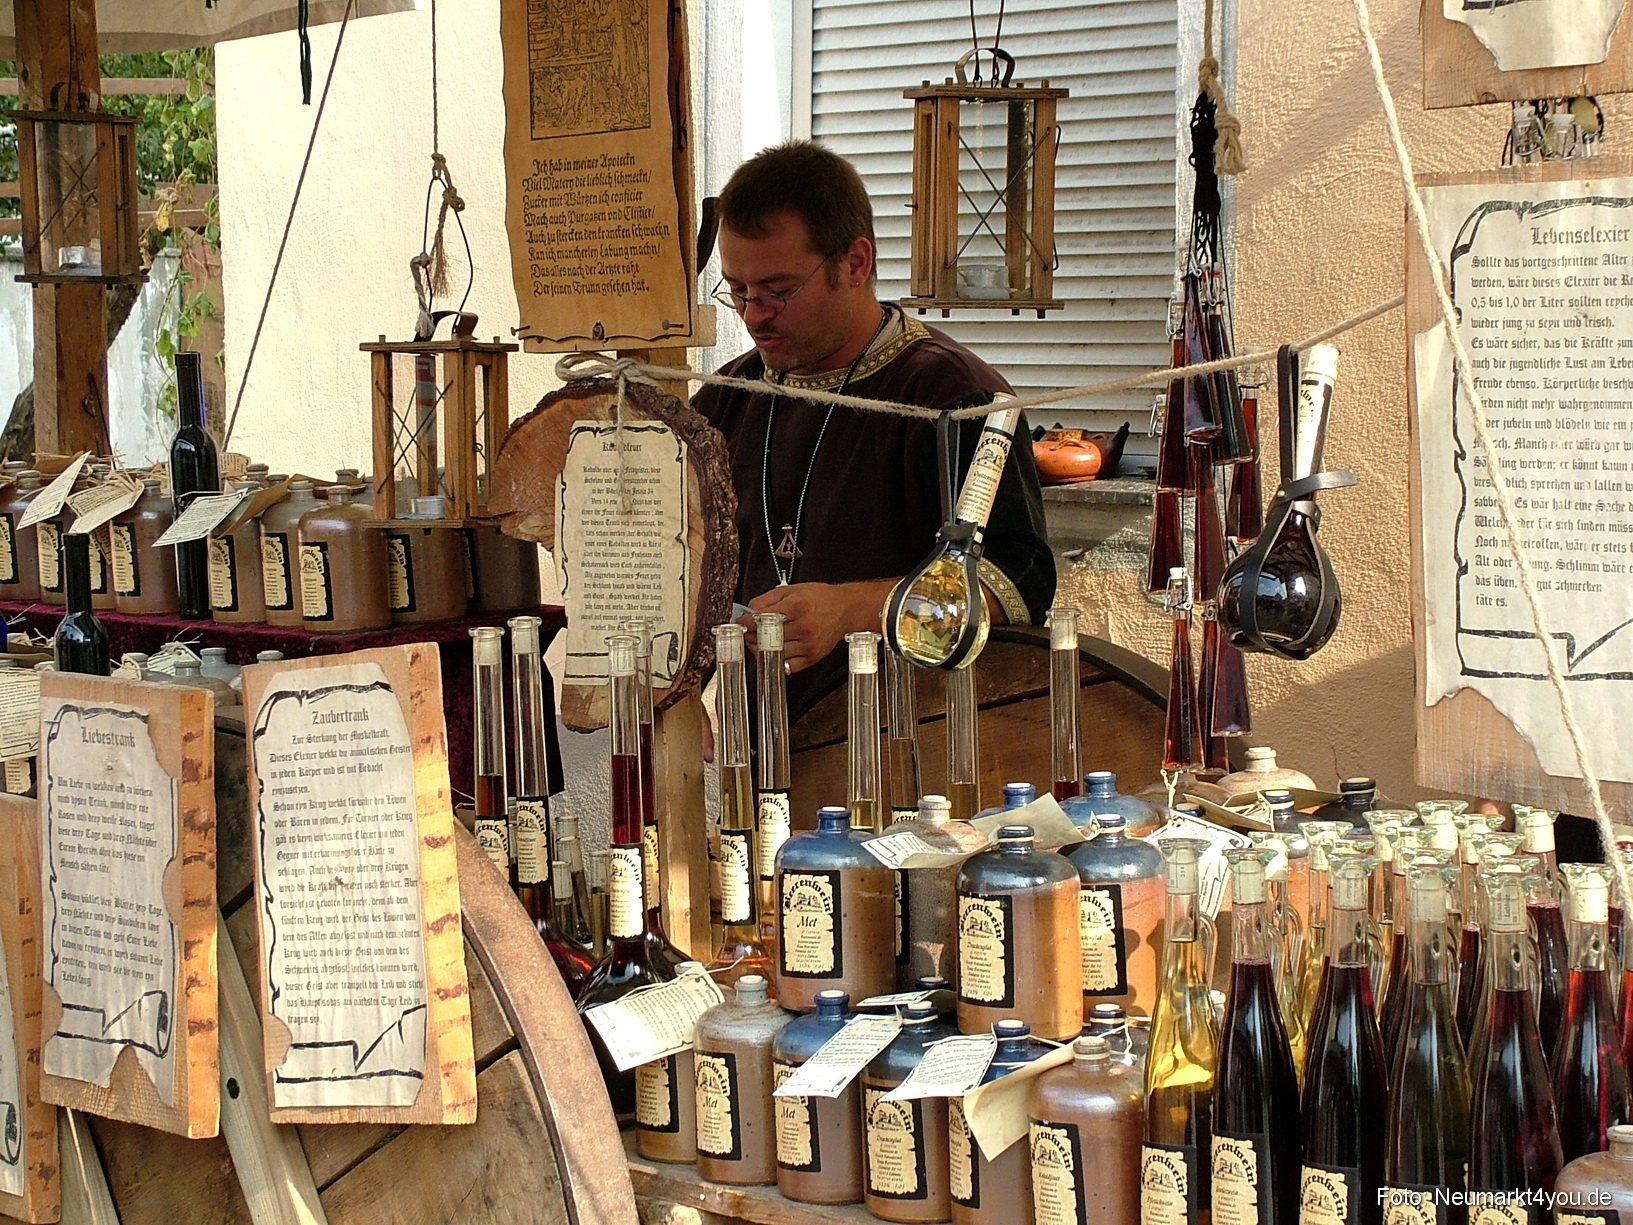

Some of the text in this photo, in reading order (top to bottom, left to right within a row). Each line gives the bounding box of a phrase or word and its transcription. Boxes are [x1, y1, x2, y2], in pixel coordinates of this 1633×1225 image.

[1530, 225, 1631, 245] Lebenselexier
[1471, 256, 1502, 268] Sollte
[1504, 256, 1520, 268] das
[1601, 253, 1628, 266] Alter
[1508, 275, 1529, 288] wäre
[1532, 276, 1561, 288] dieses
[1564, 275, 1601, 288] Elexier
[1603, 275, 1618, 287] die
[1471, 296, 1486, 309] 0,5
[1489, 297, 1503, 308] bis
[1506, 296, 1520, 308] 1,0
[1522, 297, 1537, 308] der
[1540, 296, 1565, 308] Liter
[1568, 295, 1602, 308] sollten
[1471, 317, 1500, 329] wieder
[1502, 317, 1523, 331] jung
[1525, 319, 1535, 331] zu
[1538, 317, 1560, 331] seyn
[1563, 315, 1582, 328] und
[1471, 337, 1484, 349] Es
[1486, 336, 1509, 349] wäre
[1511, 337, 1541, 350] sicher,
[1543, 337, 1561, 349] das
[1564, 337, 1578, 349] die
[1581, 335, 1614, 349] Kräfte
[1471, 357, 1490, 371] auch
[1493, 357, 1507, 369] die
[1509, 357, 1561, 371] jugendliche
[1564, 356, 1588, 369] Lust
[1591, 358, 1606, 369] am
[1506, 378, 1540, 390] ebenso.
[1542, 376, 1600, 391] Körperliche
[1506, 397, 1529, 410] nicht
[1531, 397, 1556, 410] mehr
[1502, 417, 1627, 431] jubeln und blödeln wie ein
[1513, 438, 1548, 450] Manch
[1603, 439, 1621, 453] gar
[1520, 458, 1628, 472] werden; er könnt kaum
[1530, 478, 1571, 492] sprechen
[1594, 480, 1622, 492] lallen
[1514, 496, 1626, 515] Es wär halt eine Sache
[1538, 517, 1553, 530] für
[1556, 518, 1574, 531] sich
[1577, 518, 1606, 533] finden
[1474, 534, 1498, 549] Noch
[1591, 541, 1601, 552] er
[1603, 541, 1627, 554] stets
[1475, 554, 1626, 574] Alt oder Schlimm wäre
[1475, 574, 1603, 593] das üben, gut schmecken
[1475, 594, 1508, 608] täte es.
[311, 708, 370, 725] Zaubertrank
[81, 726, 136, 748] Liebestrank
[797, 915, 818, 928] Met
[703, 1096, 718, 1109] Met
[781, 1106, 796, 1120] Met
